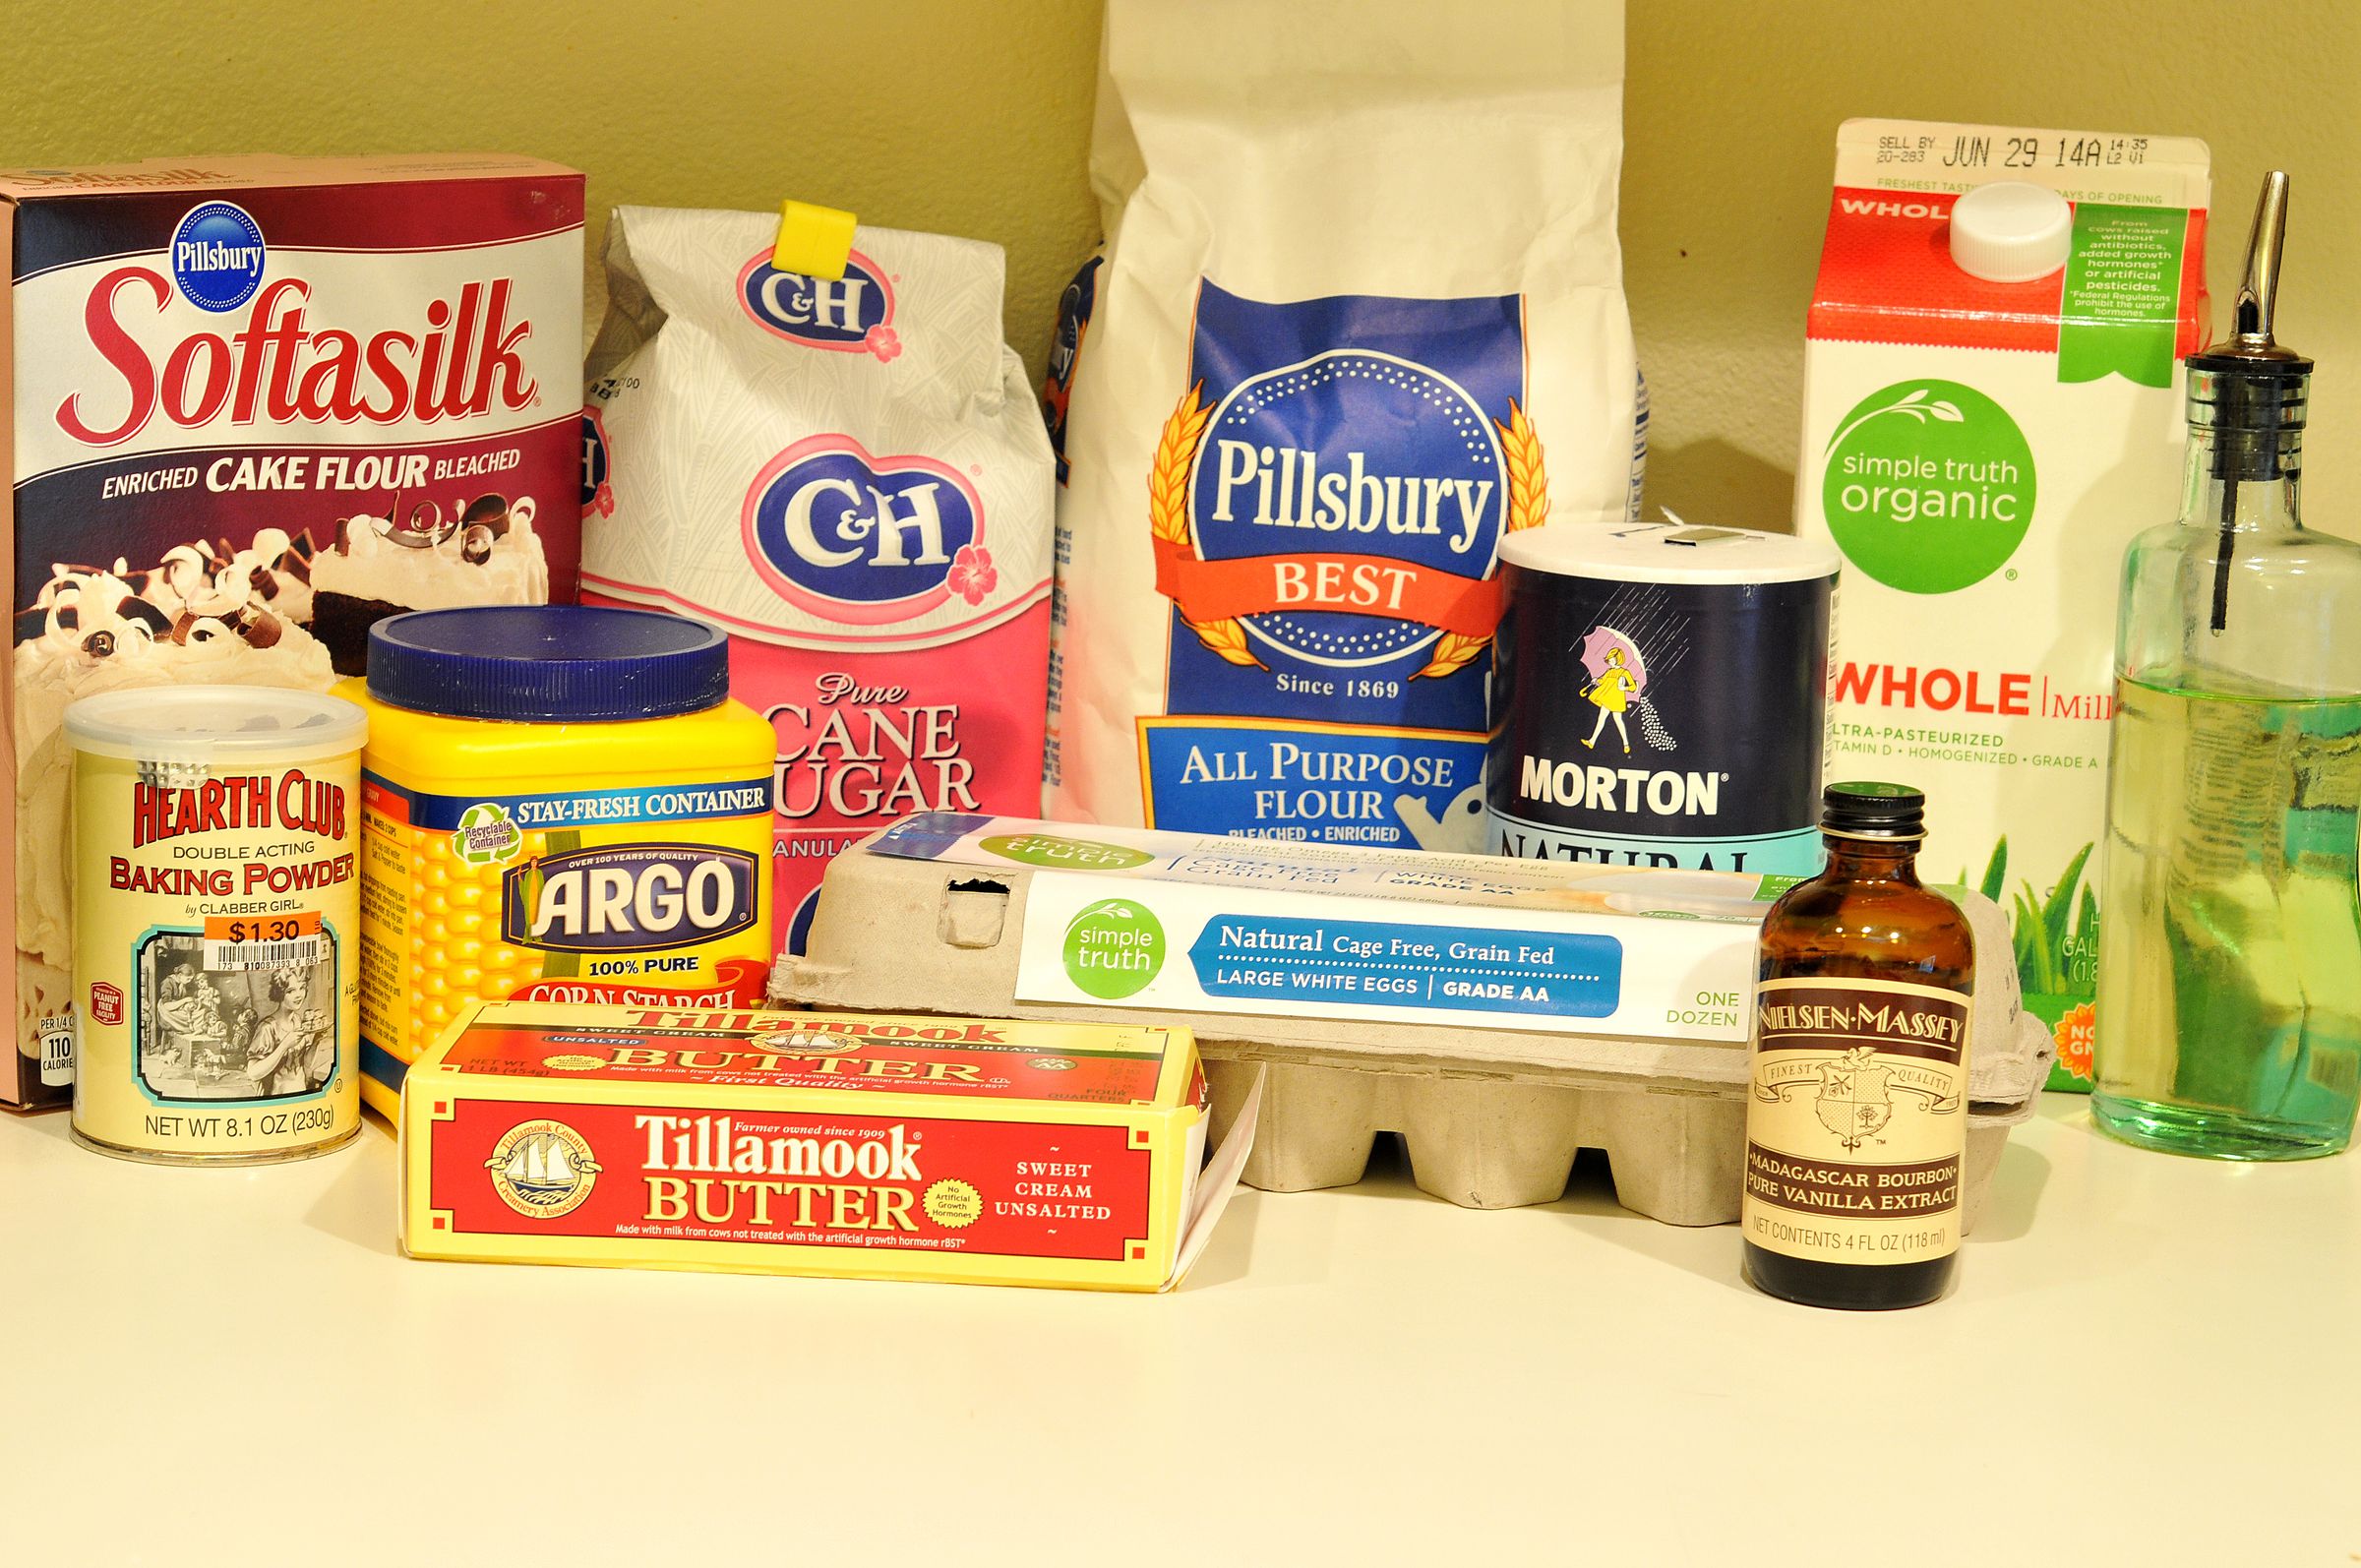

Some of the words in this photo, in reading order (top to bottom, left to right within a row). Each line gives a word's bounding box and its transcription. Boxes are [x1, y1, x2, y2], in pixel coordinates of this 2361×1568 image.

[1879, 137, 1910, 150] SELL
[1918, 137, 1936, 150] BY
[1943, 136, 1991, 167] JUN
[2005, 138, 2038, 167] 29
[2055, 138, 2101, 167] 14A
[2110, 139, 2149, 151] 14:35
[1876, 151, 1925, 164] 20-283
[2106, 152, 2122, 165] L2
[1877, 178, 1938, 191] FRESHEST
[2088, 191, 2104, 202] OF
[2108, 193, 2163, 205] OPENING
[1840, 199, 1949, 220] WHOL
[177, 240, 265, 277] Pillsbury
[2089, 242, 2166, 251] antibiotics,
[2125, 251, 2172, 260] growth
[2086, 281, 2161, 292] pesticides.
[2103, 270, 2161, 280] artificial
[760, 272, 871, 334] C&H
[2075, 299, 2114, 309] prohibit
[2116, 299, 2133, 309] the
[2112, 292, 2171, 303] Regulations
[2094, 308, 2147, 318] hormones.
[55, 266, 537, 447] Softasilk
[101, 466, 199, 500] ENRICHED
[206, 455, 310, 493] CAKE
[316, 453, 427, 492] FLOUR
[434, 449, 520, 482] BLEACHED
[1843, 452, 1938, 481] simple
[1945, 457, 2018, 484] truth
[1212, 439, 1494, 555] Pillsbury
[1841, 484, 2018, 522] organic
[784, 479, 952, 568] C&H
[1273, 562, 1418, 612] BEST
[815, 672, 909, 705] Pure
[1276, 673, 1335, 697] Since
[1346, 677, 1400, 699] 1869
[1835, 661, 2031, 716] WHOLE
[761, 703, 961, 763] CANE
[1833, 723, 2005, 748] LTRA-PASTEURIZED
[1180, 745, 1258, 785] ALL
[1269, 743, 1455, 788] PURPOSE
[1883, 745, 1893, 756] D
[1908, 746, 2018, 765] HOMOGENIZED
[2031, 754, 2083, 769] GRADE
[2088, 757, 2099, 769] A
[773, 757, 981, 817] UGAR
[1520, 754, 1720, 816] MORTON
[133, 775, 272, 849] HEARTH
[277, 768, 345, 841] CLUB
[517, 793, 643, 824] STAY-FRESH
[645, 786, 766, 818] CONTAINER
[1254, 789, 1386, 820] FLOUR
[464, 819, 513, 838] Recyclable
[1229, 826, 1306, 842] BLEACHED
[1324, 826, 1401, 842] ENRICHED
[173, 845, 250, 859] DOUBLE
[255, 840, 315, 858] ACTING
[469, 834, 512, 850] Container
[569, 857, 594, 869] OVER
[594, 855, 612, 865] 100
[613, 853, 644, 863] YEARS
[645, 852, 658, 861] OF
[658, 853, 699, 862] QUALITY
[109, 855, 233, 896] BAKING
[243, 852, 355, 896] POWDER
[185, 904, 197, 918] by
[200, 902, 267, 915] CLABBER
[270, 899, 300, 912] GIRL
[531, 859, 735, 937] ARGO
[228, 920, 300, 944] $1.30
[1079, 926, 1153, 949] simple
[1078, 944, 1151, 971] truth
[1220, 925, 1323, 952] Natural
[1333, 935, 1383, 959] Cage
[1390, 937, 1440, 960] Free,
[1448, 941, 1511, 963] Grain
[1517, 944, 1555, 966] Fed
[588, 959, 639, 977] 100%
[642, 956, 699, 974] PURE
[93, 991, 120, 1004] PEANUT
[529, 985, 616, 1005] CORN
[622, 989, 736, 1010] STARCH
[1216, 969, 1285, 988] LARGE
[1291, 972, 1357, 993] WHITE
[1363, 977, 1419, 995] EGGS
[1442, 980, 1514, 1001] GRADE
[1519, 985, 1550, 1003] AA
[98, 1001, 113, 1012] FREE
[1696, 990, 1740, 1008] ONE
[40, 1017, 55, 1029] PER
[56, 1016, 67, 1029] 1/4
[626, 1010, 1007, 1045] Tillamook
[1666, 1009, 1739, 1028] DOZEN
[48, 1037, 71, 1059] 110
[553, 1036, 639, 1045] UNSALTED
[42, 1057, 74, 1071] CALORIE
[607, 1048, 985, 1082] BUTTER
[707, 1075, 767, 1085] First
[774, 1076, 865, 1091] Quality
[1770, 1063, 1814, 1080] FINEST
[1898, 1068, 1951, 1092] QUALITY
[145, 1115, 184, 1137] NET
[188, 1116, 221, 1137] WT
[226, 1117, 253, 1138] 8.1
[260, 1115, 287, 1136] OZ
[291, 1105, 335, 1136] (230g)
[734, 1120, 781, 1133] Farmer
[782, 1122, 822, 1136] owned
[824, 1124, 855, 1137] since
[857, 1127, 886, 1140] 1909
[500, 1122, 552, 1151] Tillamook
[555, 1123, 589, 1156] County
[635, 1114, 923, 1181] Tillamook
[1016, 1161, 1093, 1178] SWEET
[1750, 1152, 1869, 1188] MADAGASCAR
[1877, 1166, 1955, 1188] BOURBON
[498, 1180, 541, 1218] Creamery
[541, 1183, 591, 1217] Association
[936, 1193, 972, 1203] Artificial
[947, 1185, 960, 1194] No
[1014, 1181, 1093, 1199] CREAM
[1747, 1172, 1780, 1198] PURE
[1783, 1184, 1876, 1211] VANILLA
[1880, 1184, 1959, 1211] EXTRACT
[641, 1176, 921, 1232] BUTTER
[932, 1209, 973, 1220] Hormones
[938, 1201, 968, 1211] Growth
[995, 1201, 1112, 1221] UNSALTED
[615, 1223, 639, 1235] Made
[641, 1225, 662, 1236] with
[664, 1225, 684, 1236] milk
[685, 1226, 707, 1237] from
[708, 1229, 731, 1238] cows
[733, 1229, 749, 1238] not
[750, 1230, 784, 1241] treated
[785, 1231, 807, 1242] with
[808, 1232, 824, 1242] the
[824, 1233, 864, 1245] artificial
[865, 1235, 897, 1246] growth
[898, 1236, 939, 1248] hormone
[1753, 1215, 1772, 1236] NET
[1772, 1221, 1842, 1250] CONTENTS
[1846, 1236, 1854, 1251] 4
[1859, 1236, 1876, 1251] FL
[1880, 1236, 1899, 1252] OZ
[1902, 1235, 1928, 1253] (118
[1930, 1227, 1946, 1249] ml)
